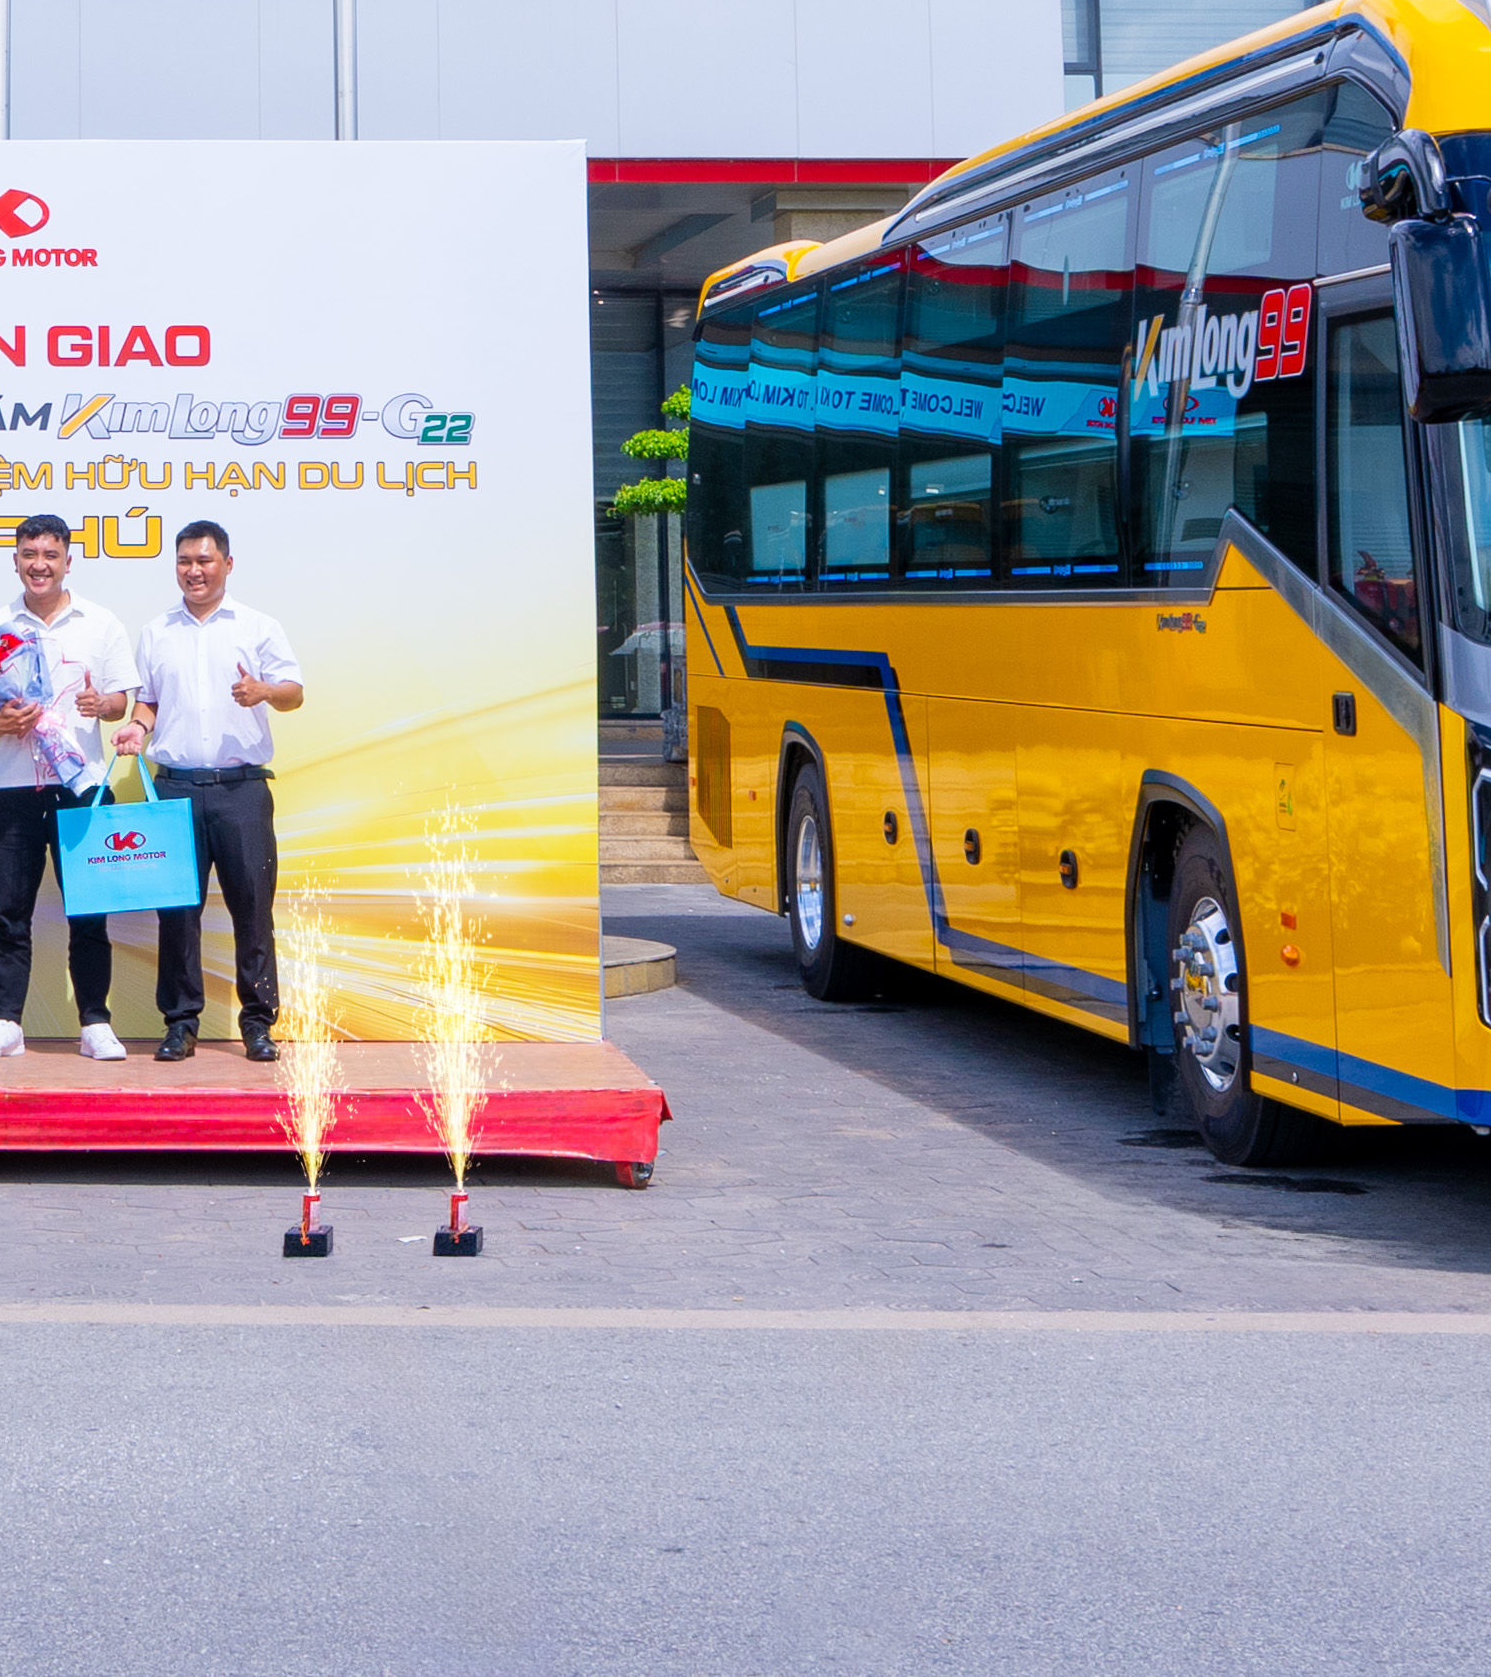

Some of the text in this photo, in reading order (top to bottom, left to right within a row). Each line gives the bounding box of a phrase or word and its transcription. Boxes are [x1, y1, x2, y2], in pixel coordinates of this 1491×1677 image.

[12, 248, 98, 267] MOTOR
[47, 325, 210, 367] GIAO
[65, 454, 172, 490] HỮU
[185, 461, 285, 497] HẠN
[298, 461, 364, 490] DU
[377, 461, 478, 497] LỊCH
[87, 851, 167, 865] KIM LONG MOTOR
